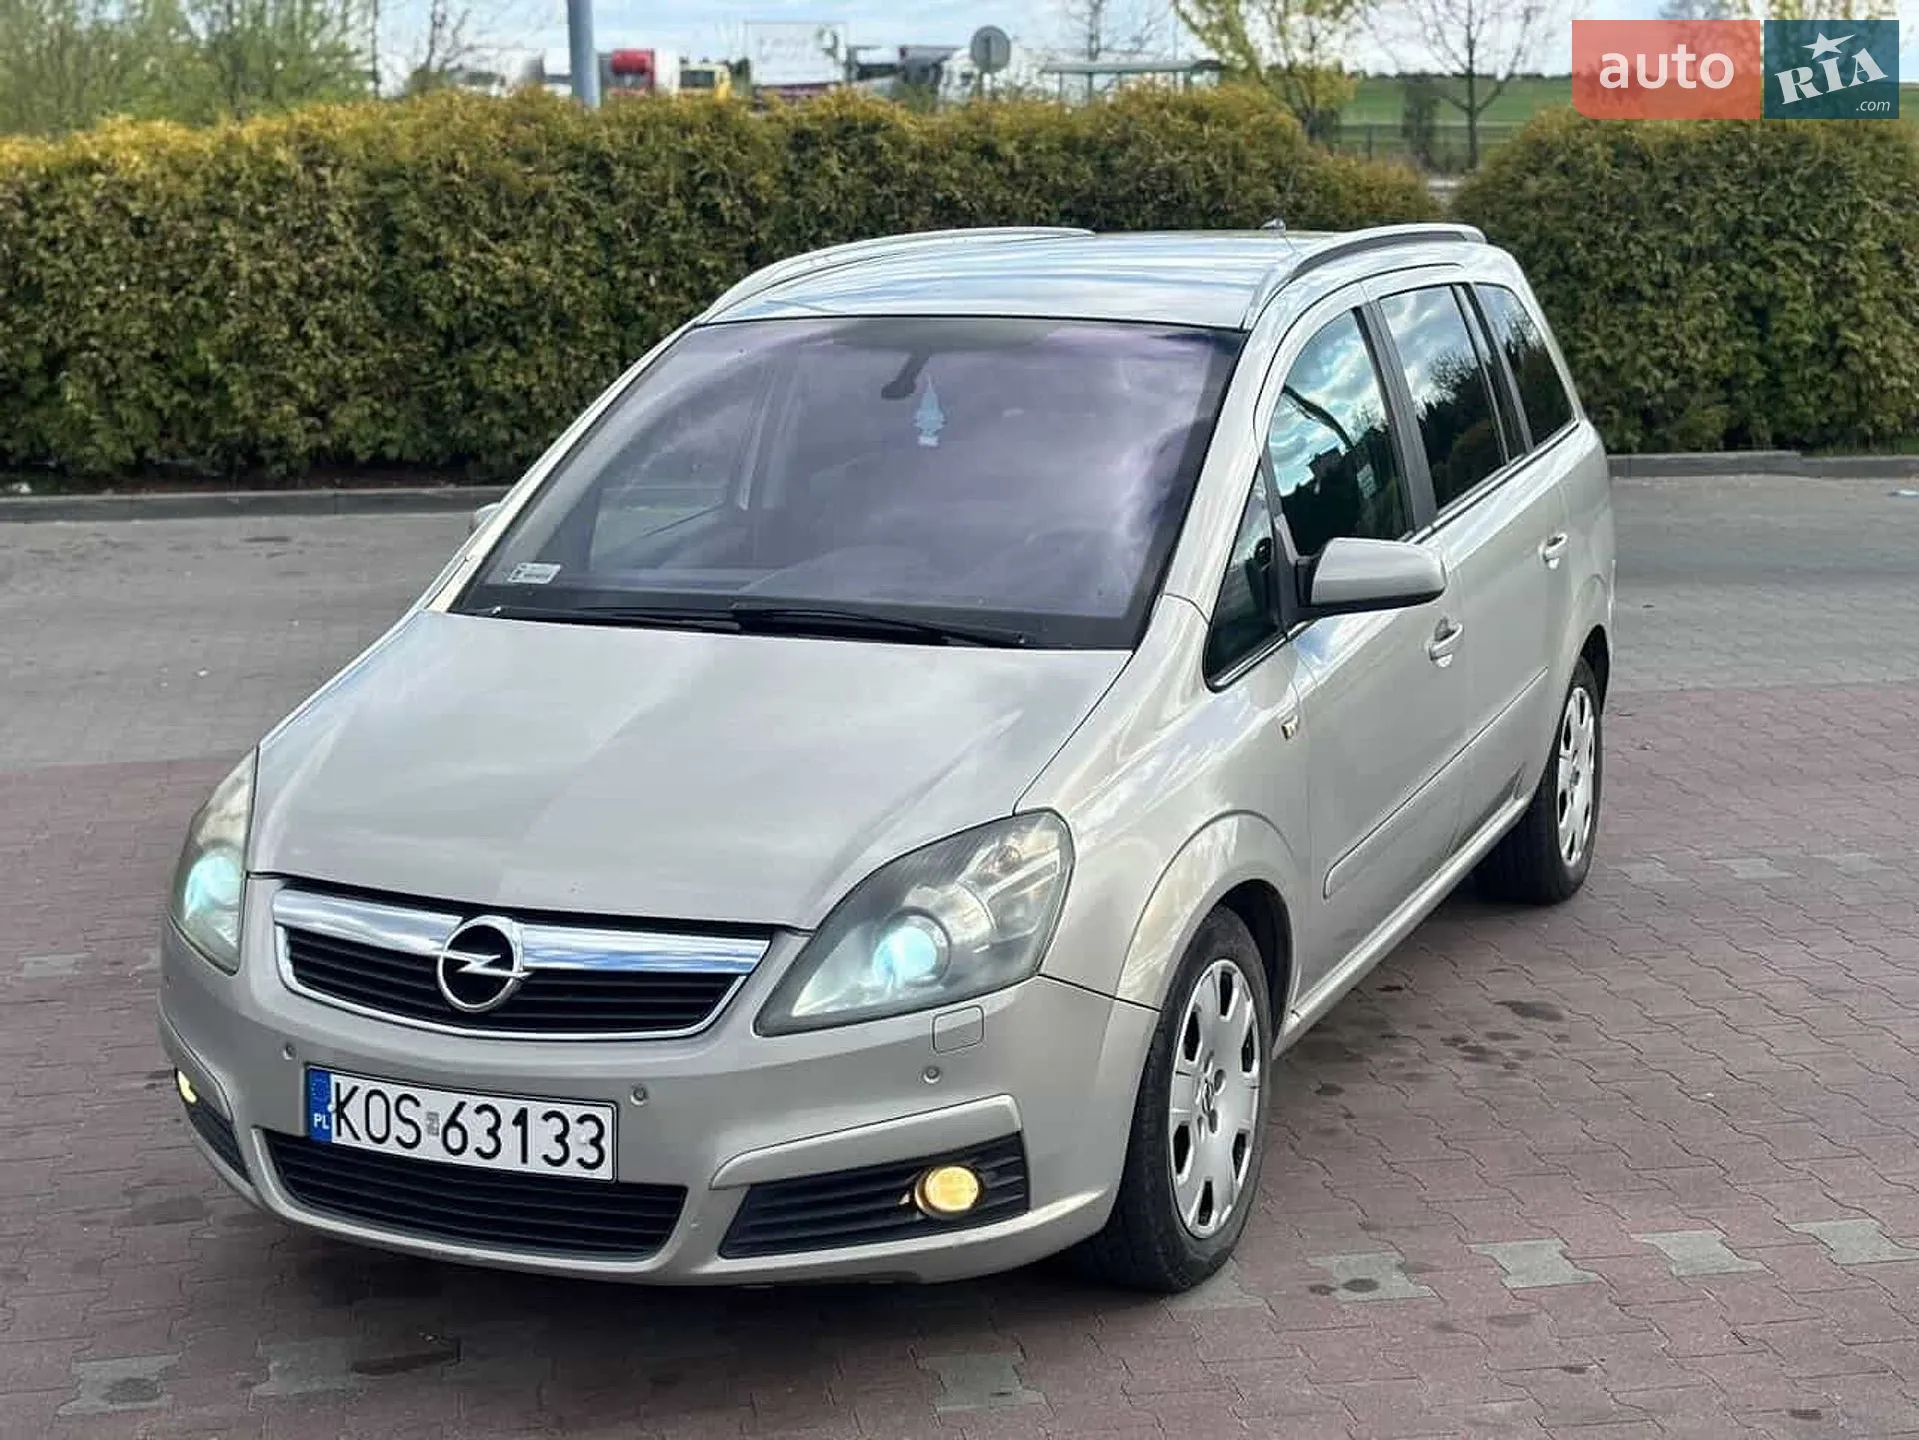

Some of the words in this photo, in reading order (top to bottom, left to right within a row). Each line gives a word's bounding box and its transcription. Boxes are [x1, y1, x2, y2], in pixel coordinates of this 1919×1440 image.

[314, 1114, 330, 1130] PL
[335, 1082, 422, 1149] KOS
[442, 1101, 605, 1170] 63133
